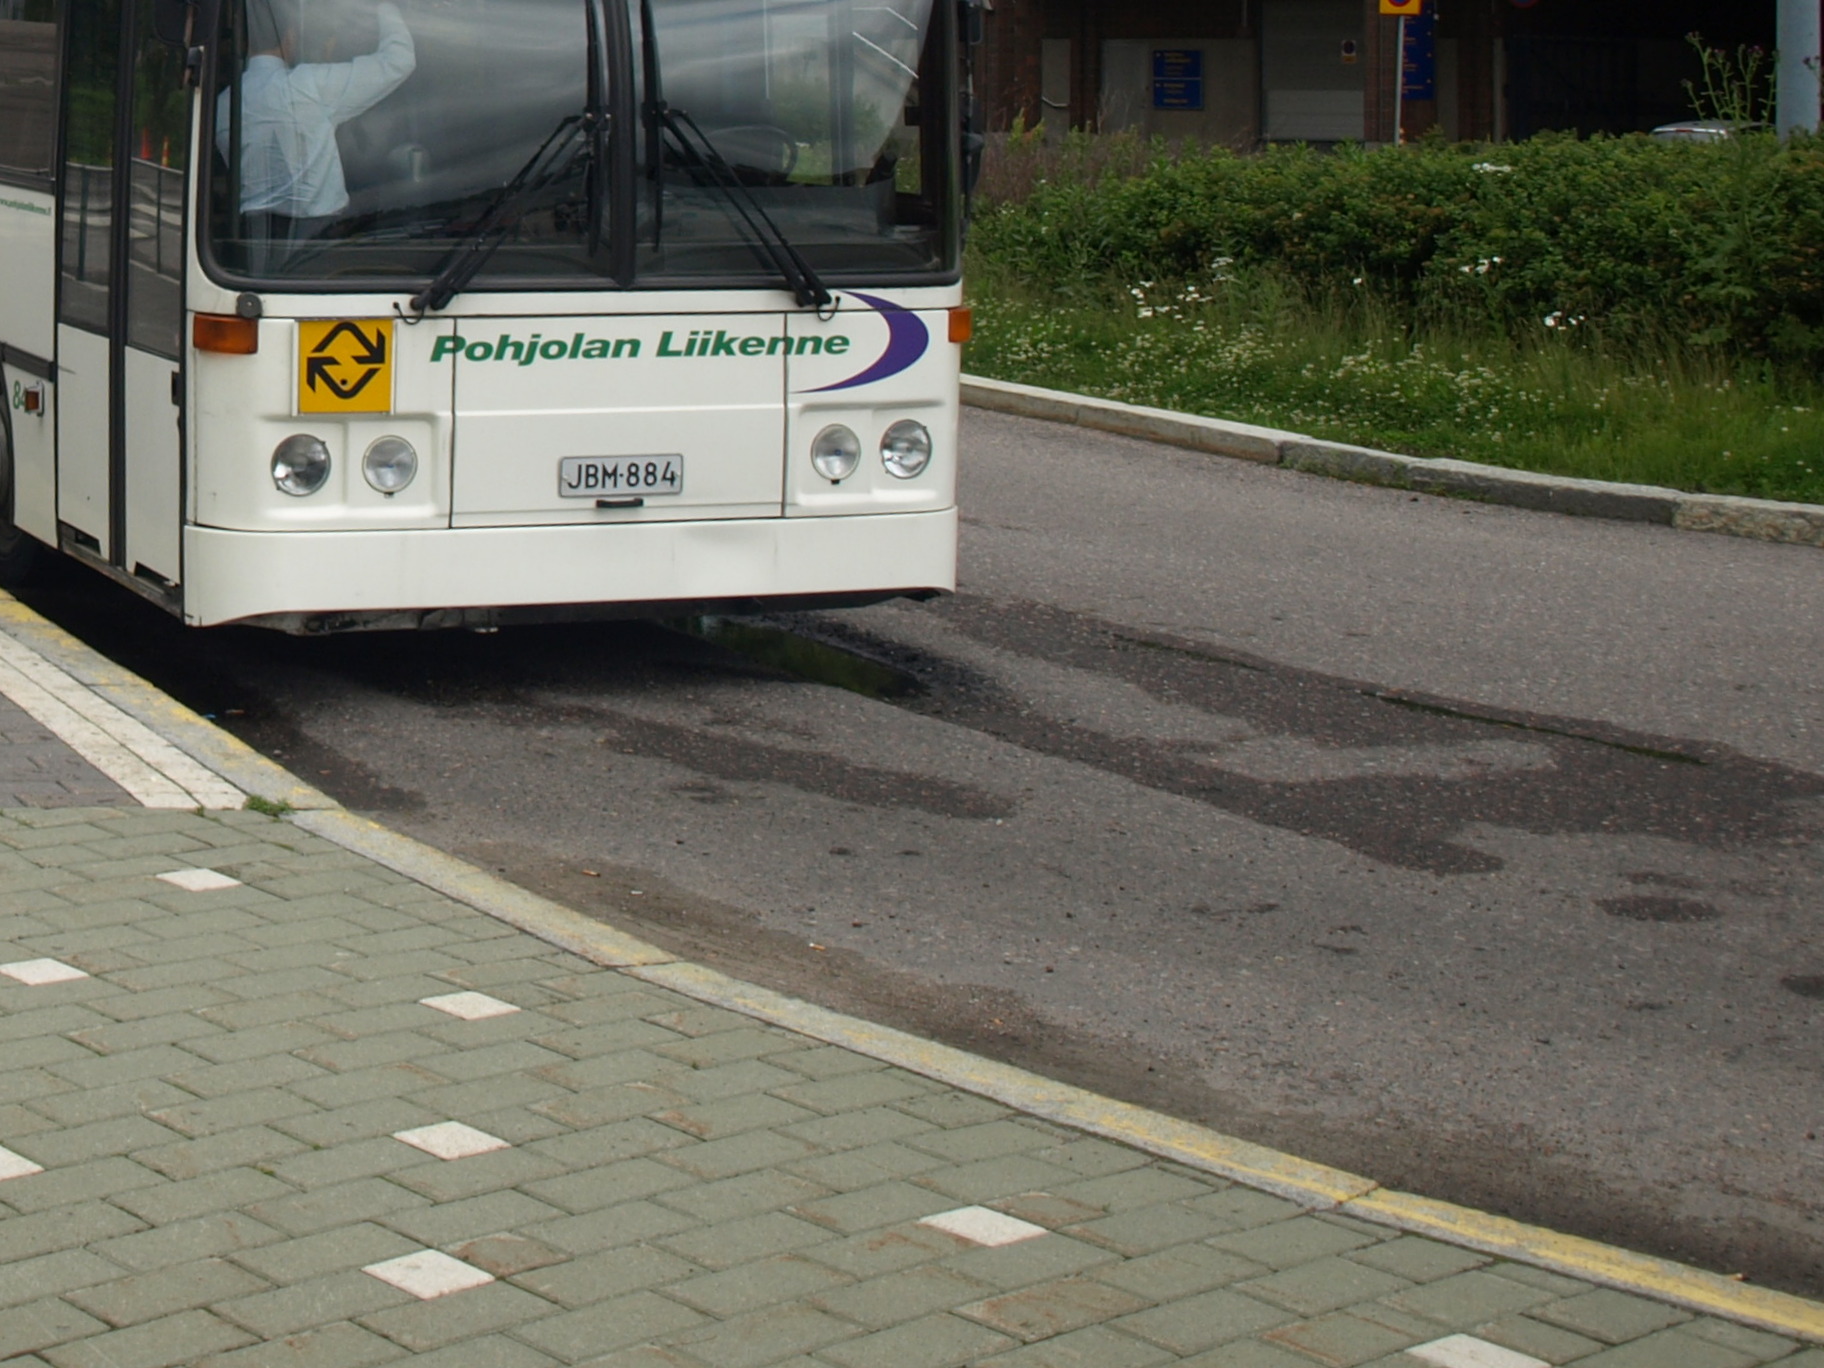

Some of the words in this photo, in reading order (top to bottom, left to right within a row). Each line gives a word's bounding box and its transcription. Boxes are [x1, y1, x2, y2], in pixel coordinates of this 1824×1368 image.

[430, 333, 642, 367] Pohjolan
[656, 331, 851, 358] Liikenne
[567, 460, 677, 490] JBM-884
